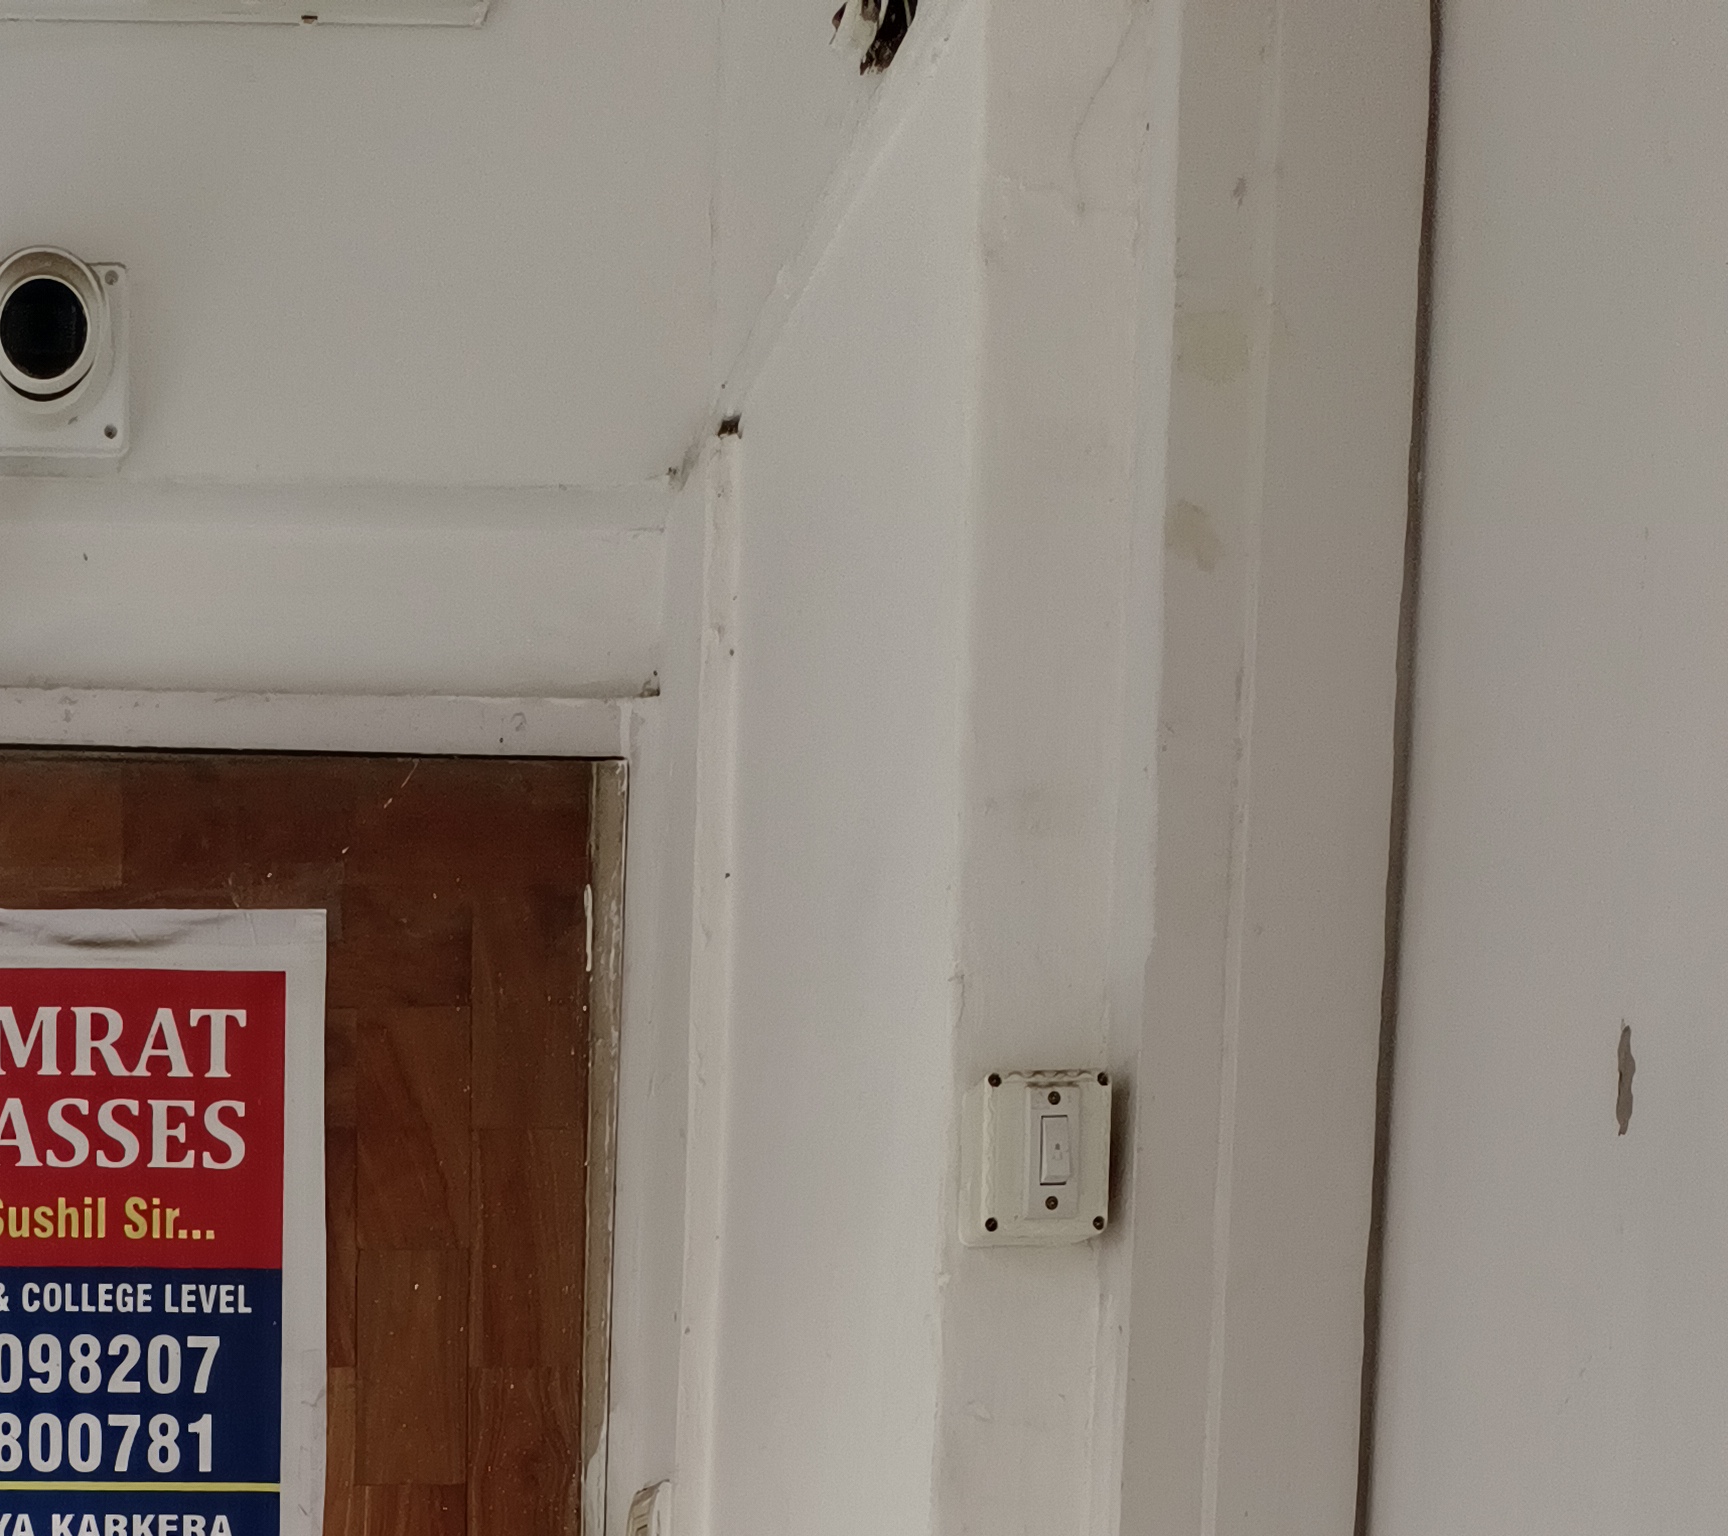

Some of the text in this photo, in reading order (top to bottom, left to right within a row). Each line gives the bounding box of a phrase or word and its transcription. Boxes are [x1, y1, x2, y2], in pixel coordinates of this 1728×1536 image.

[123, 1196, 215, 1240] Sir...
[21, 1282, 153, 1313] COLLEGE
[164, 1283, 253, 1314] LEVEL
